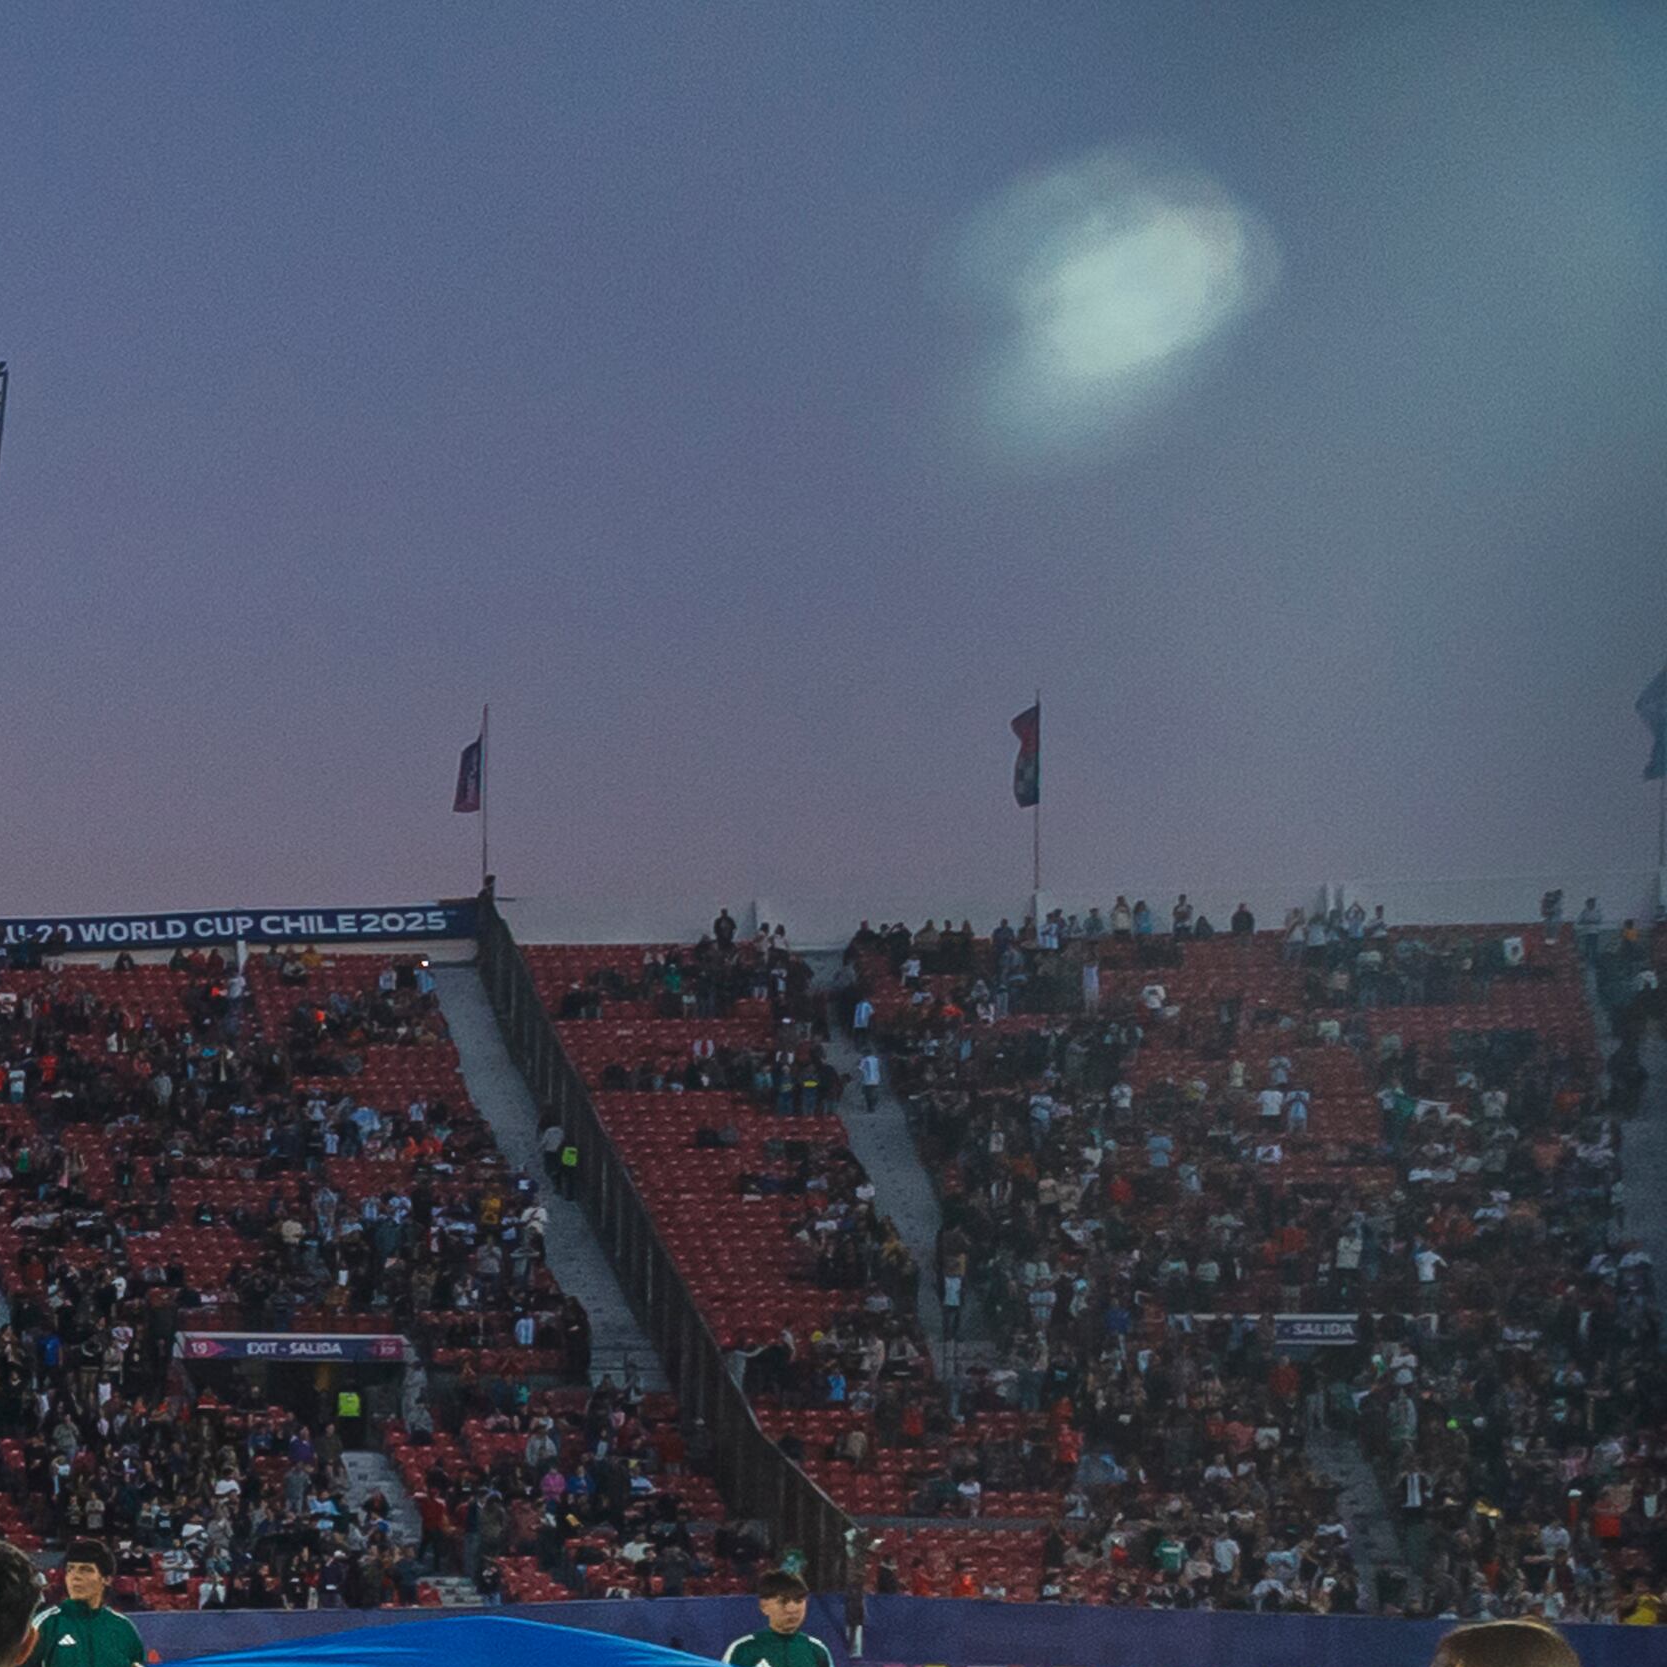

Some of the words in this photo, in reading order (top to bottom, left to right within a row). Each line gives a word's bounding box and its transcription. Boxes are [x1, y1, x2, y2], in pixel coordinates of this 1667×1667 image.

[78, 920, 187, 943] WORLD
[193, 916, 254, 937] CUP
[260, 914, 358, 935] CHILE
[1292, 1322, 1355, 1336] SALIDA
[246, 1341, 278, 1355] EXIT
[289, 1341, 343, 1355] SALIDA
